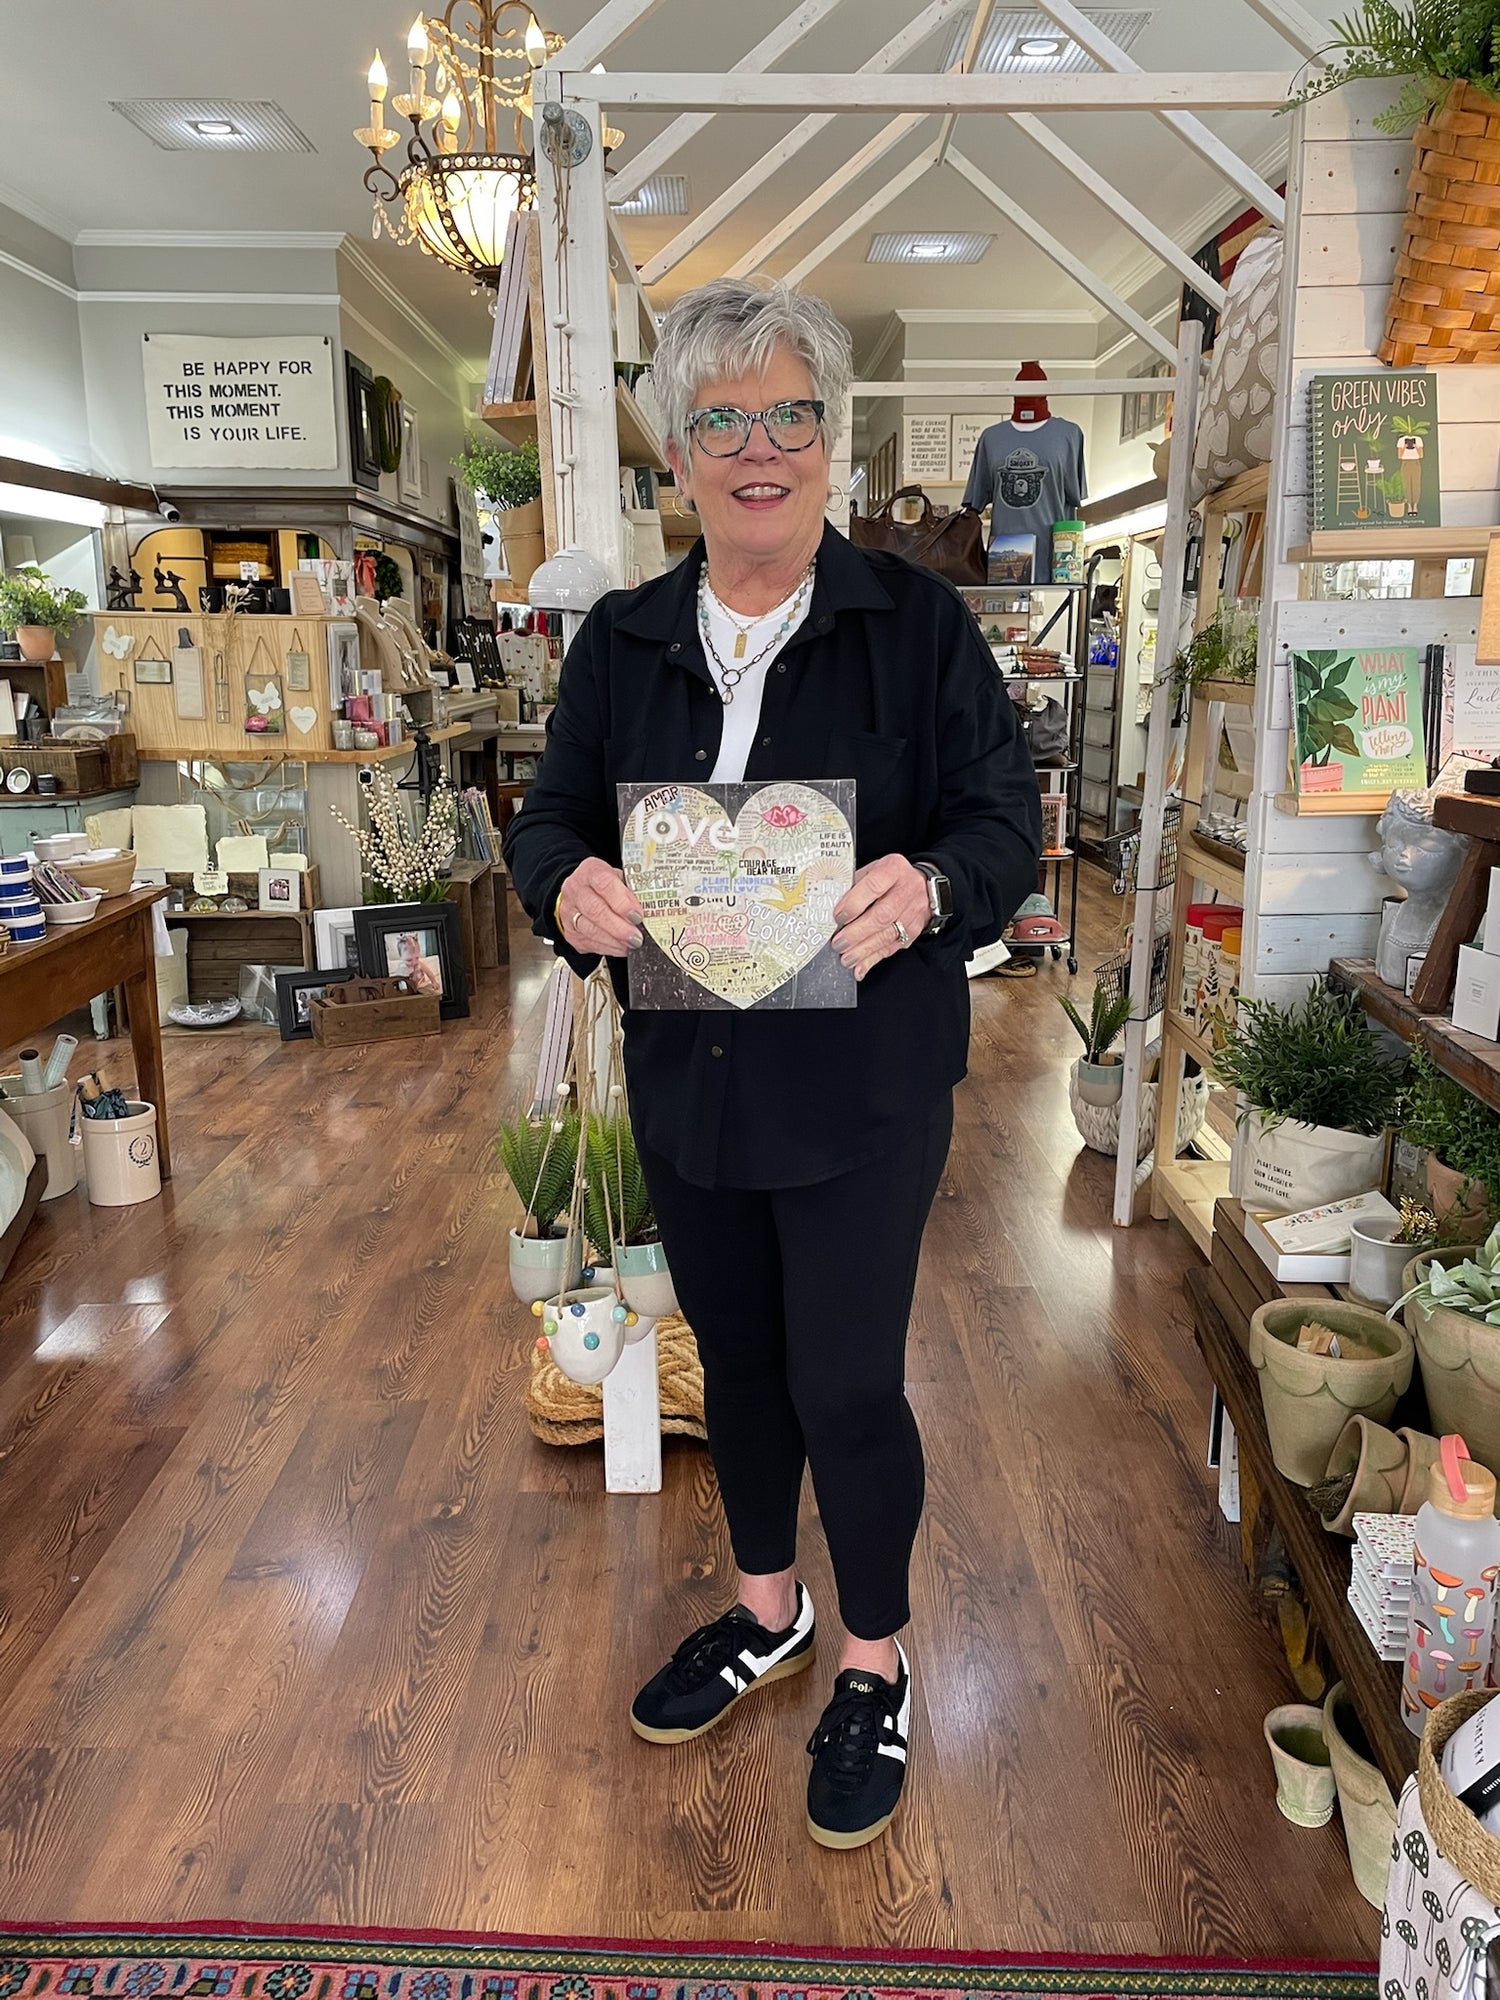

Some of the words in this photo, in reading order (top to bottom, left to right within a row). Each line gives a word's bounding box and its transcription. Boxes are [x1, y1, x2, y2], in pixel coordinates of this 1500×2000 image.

[183, 362, 205, 376] BE
[214, 361, 270, 376] HAPPY
[279, 361, 313, 375] FOR
[163, 384, 202, 399] THIS
[209, 383, 282, 398] MOMENT.
[1331, 380, 1381, 412] GREEN
[1386, 379, 1427, 408] VIBES
[166, 405, 204, 419] THIS
[211, 403, 281, 418] MOMENT
[1332, 406, 1388, 440] only
[184, 427, 201, 440] IS
[210, 427, 260, 441] YOUR
[266, 426, 307, 440] LIFE.
[1359, 652, 1405, 674] WHAT
[1364, 679, 1377, 694] is
[1377, 674, 1408, 694] my
[1361, 691, 1409, 726] PLANT
[643, 786, 679, 813] AMOR
[820, 832, 837, 840] LIFE
[838, 832, 847, 840] IS
[820, 841, 852, 849] BEAUTY
[820, 850, 840, 858] FULL
[738, 859, 777, 869] COURAGE
[746, 867, 768, 876] DEAR
[770, 866, 797, 875] HEART
[702, 877, 729, 885] PLANT
[734, 877, 774, 885] KINDNESS
[656, 889, 678, 899] OPEN
[694, 885, 730, 894] GATHER
[658, 899, 680, 908] OPEN
[726, 895, 736, 907] U
[744, 899, 771, 920] YOU
[774, 912, 805, 935] ARE
[802, 927, 823, 946] SO
[747, 919, 809, 957] LOVED
[751, 985, 771, 1001] LOVE
[776, 966, 797, 985] FEAR
[140, 1141, 148, 1156] 2
